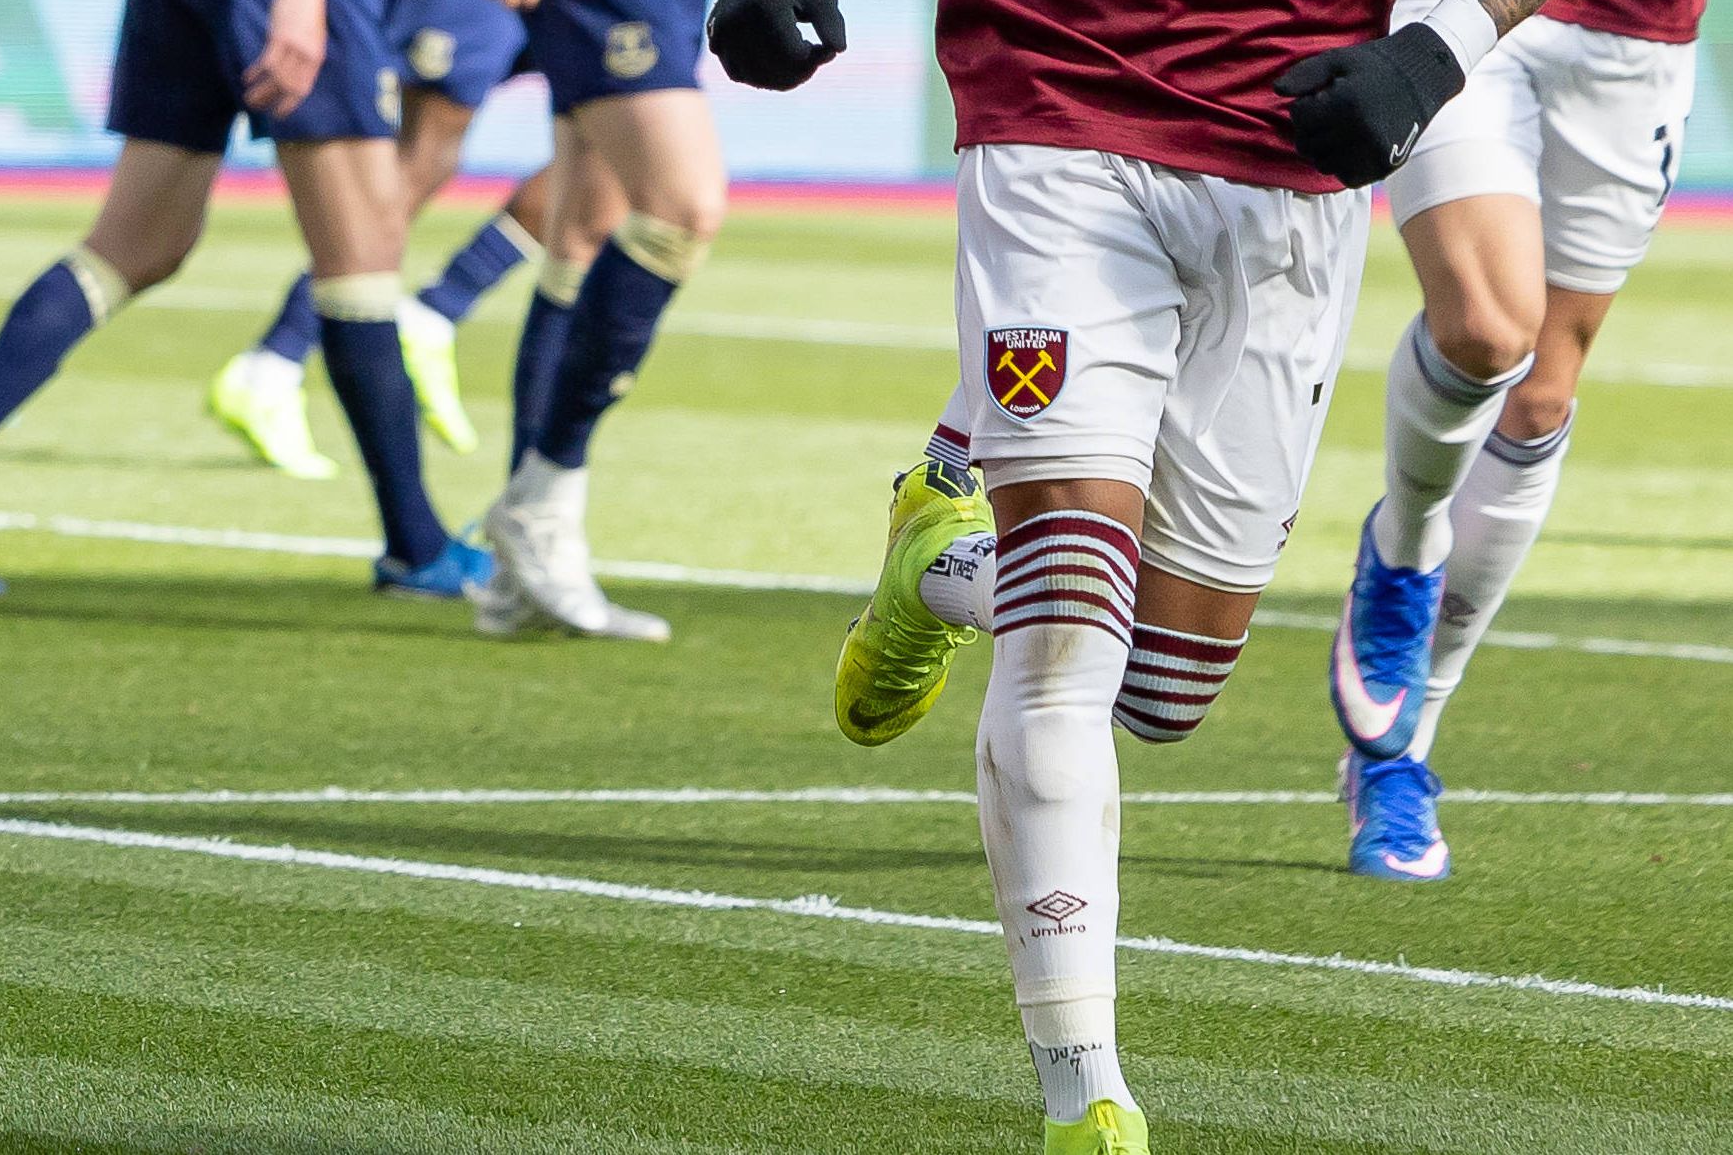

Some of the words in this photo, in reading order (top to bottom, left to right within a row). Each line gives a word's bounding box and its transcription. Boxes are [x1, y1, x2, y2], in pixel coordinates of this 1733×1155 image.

[993, 330, 1027, 343] WEST
[1029, 330, 1062, 343] HAM
[1006, 339, 1047, 349] UNITED
[1009, 404, 1041, 413] LONDON
[1031, 923, 1086, 937] umbro
